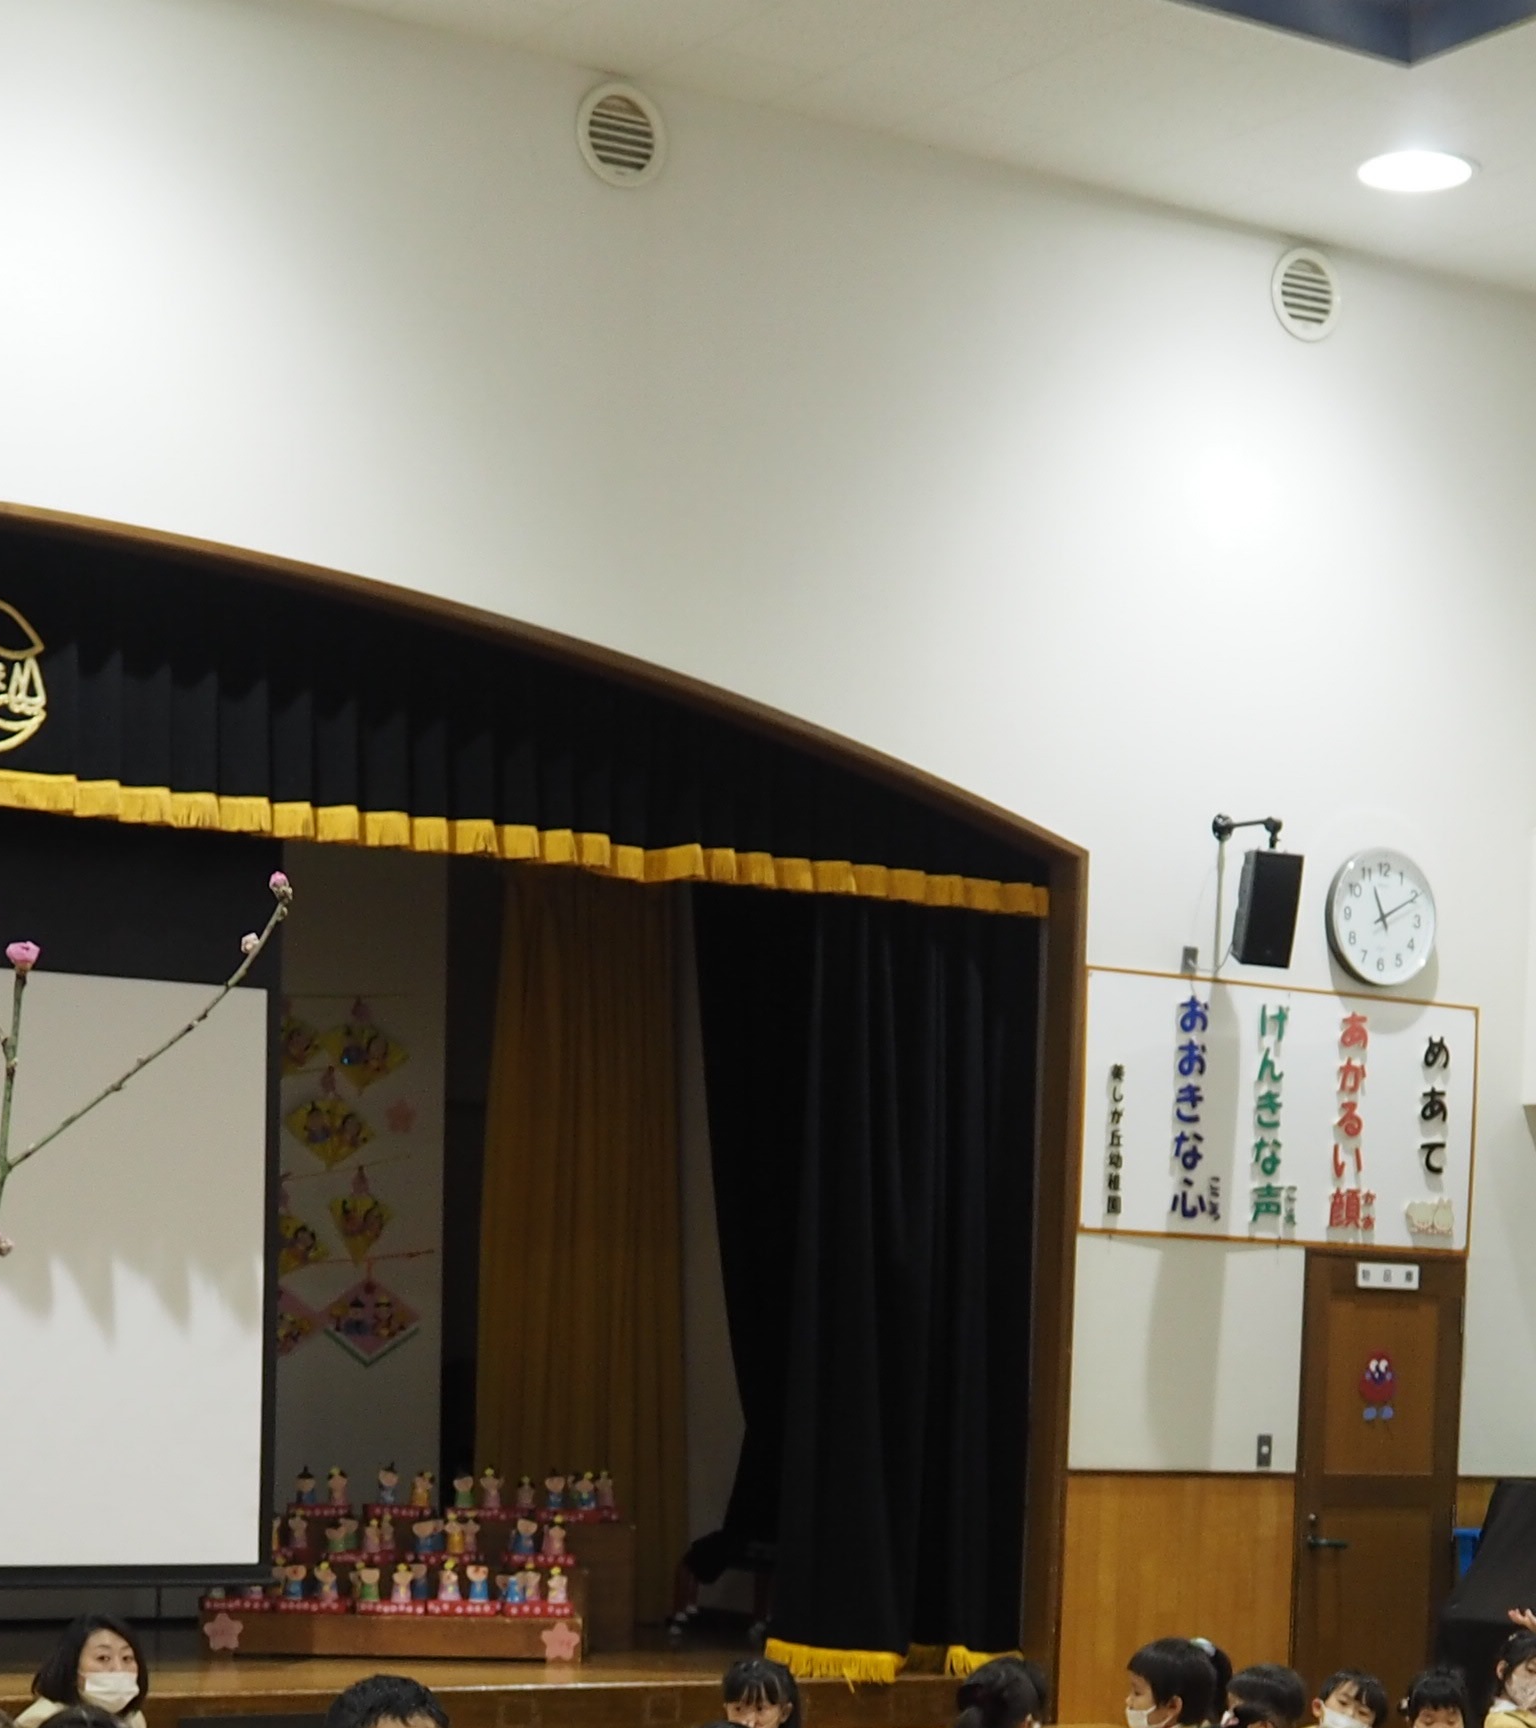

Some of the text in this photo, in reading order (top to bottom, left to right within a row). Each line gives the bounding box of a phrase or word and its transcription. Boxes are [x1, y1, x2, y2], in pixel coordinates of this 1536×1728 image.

[1106, 1064, 1126, 1215] 美しが丘幼稚園
[1171, 996, 1209, 1218] おおきな心
[1252, 1004, 1289, 1222] げんきな声
[1330, 1012, 1369, 1229] あかるい顔
[1420, 1036, 1450, 1174] めあて
